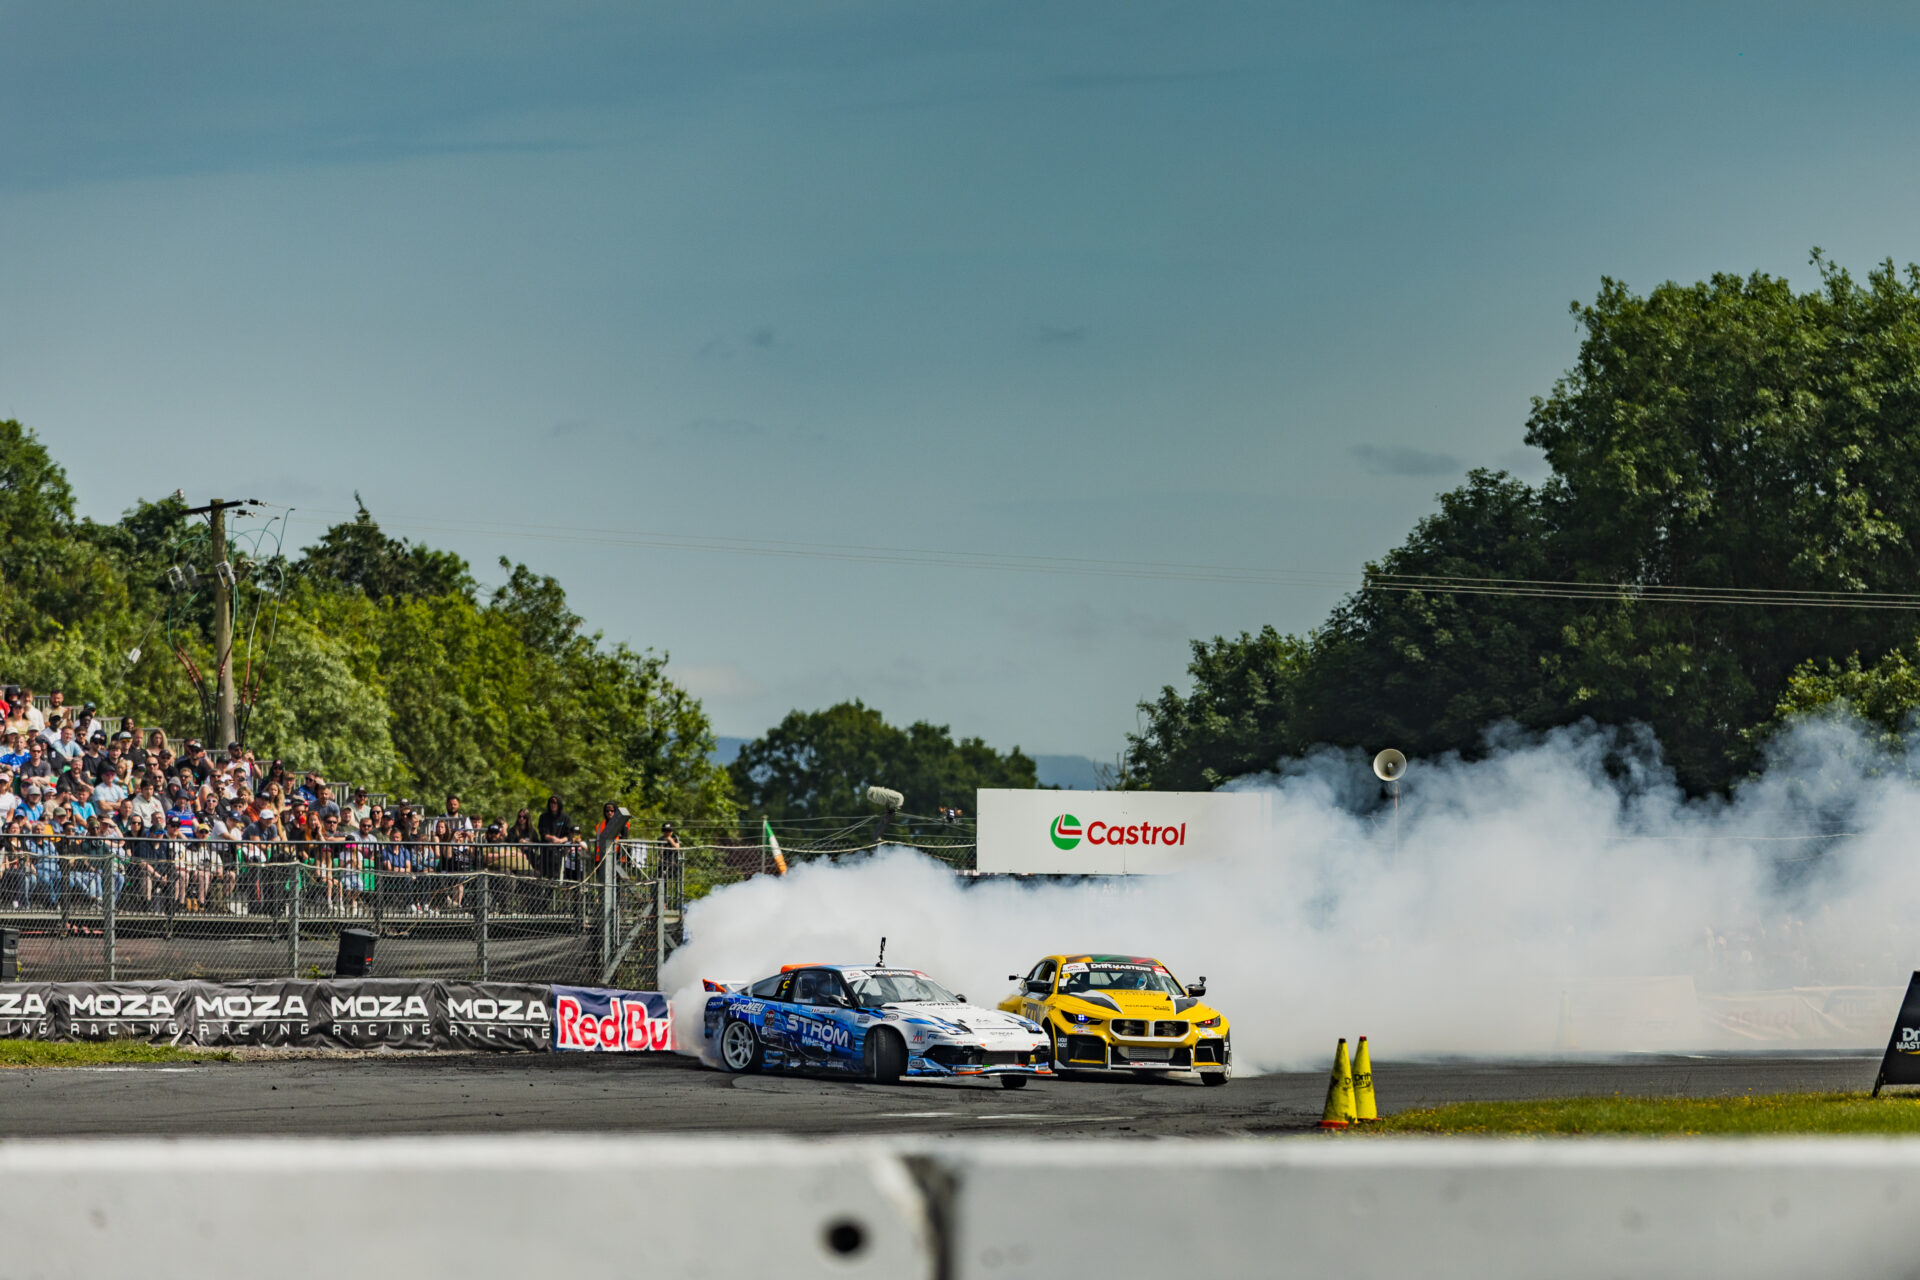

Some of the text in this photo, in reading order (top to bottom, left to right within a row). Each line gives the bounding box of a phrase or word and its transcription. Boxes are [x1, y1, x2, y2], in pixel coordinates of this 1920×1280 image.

[1087, 820, 1186, 846] Castrol
[69, 993, 175, 1016] MOZA
[195, 995, 308, 1017] MOZA
[331, 995, 429, 1017] MOZA
[447, 997, 549, 1022] MOZA
[70, 1022, 179, 1036] RACING
[199, 1023, 310, 1036] RACING
[332, 1023, 431, 1036] RACING
[450, 1025, 550, 1040] RACING
[556, 995, 621, 1051] Red
[786, 1013, 849, 1048] STRÖM
